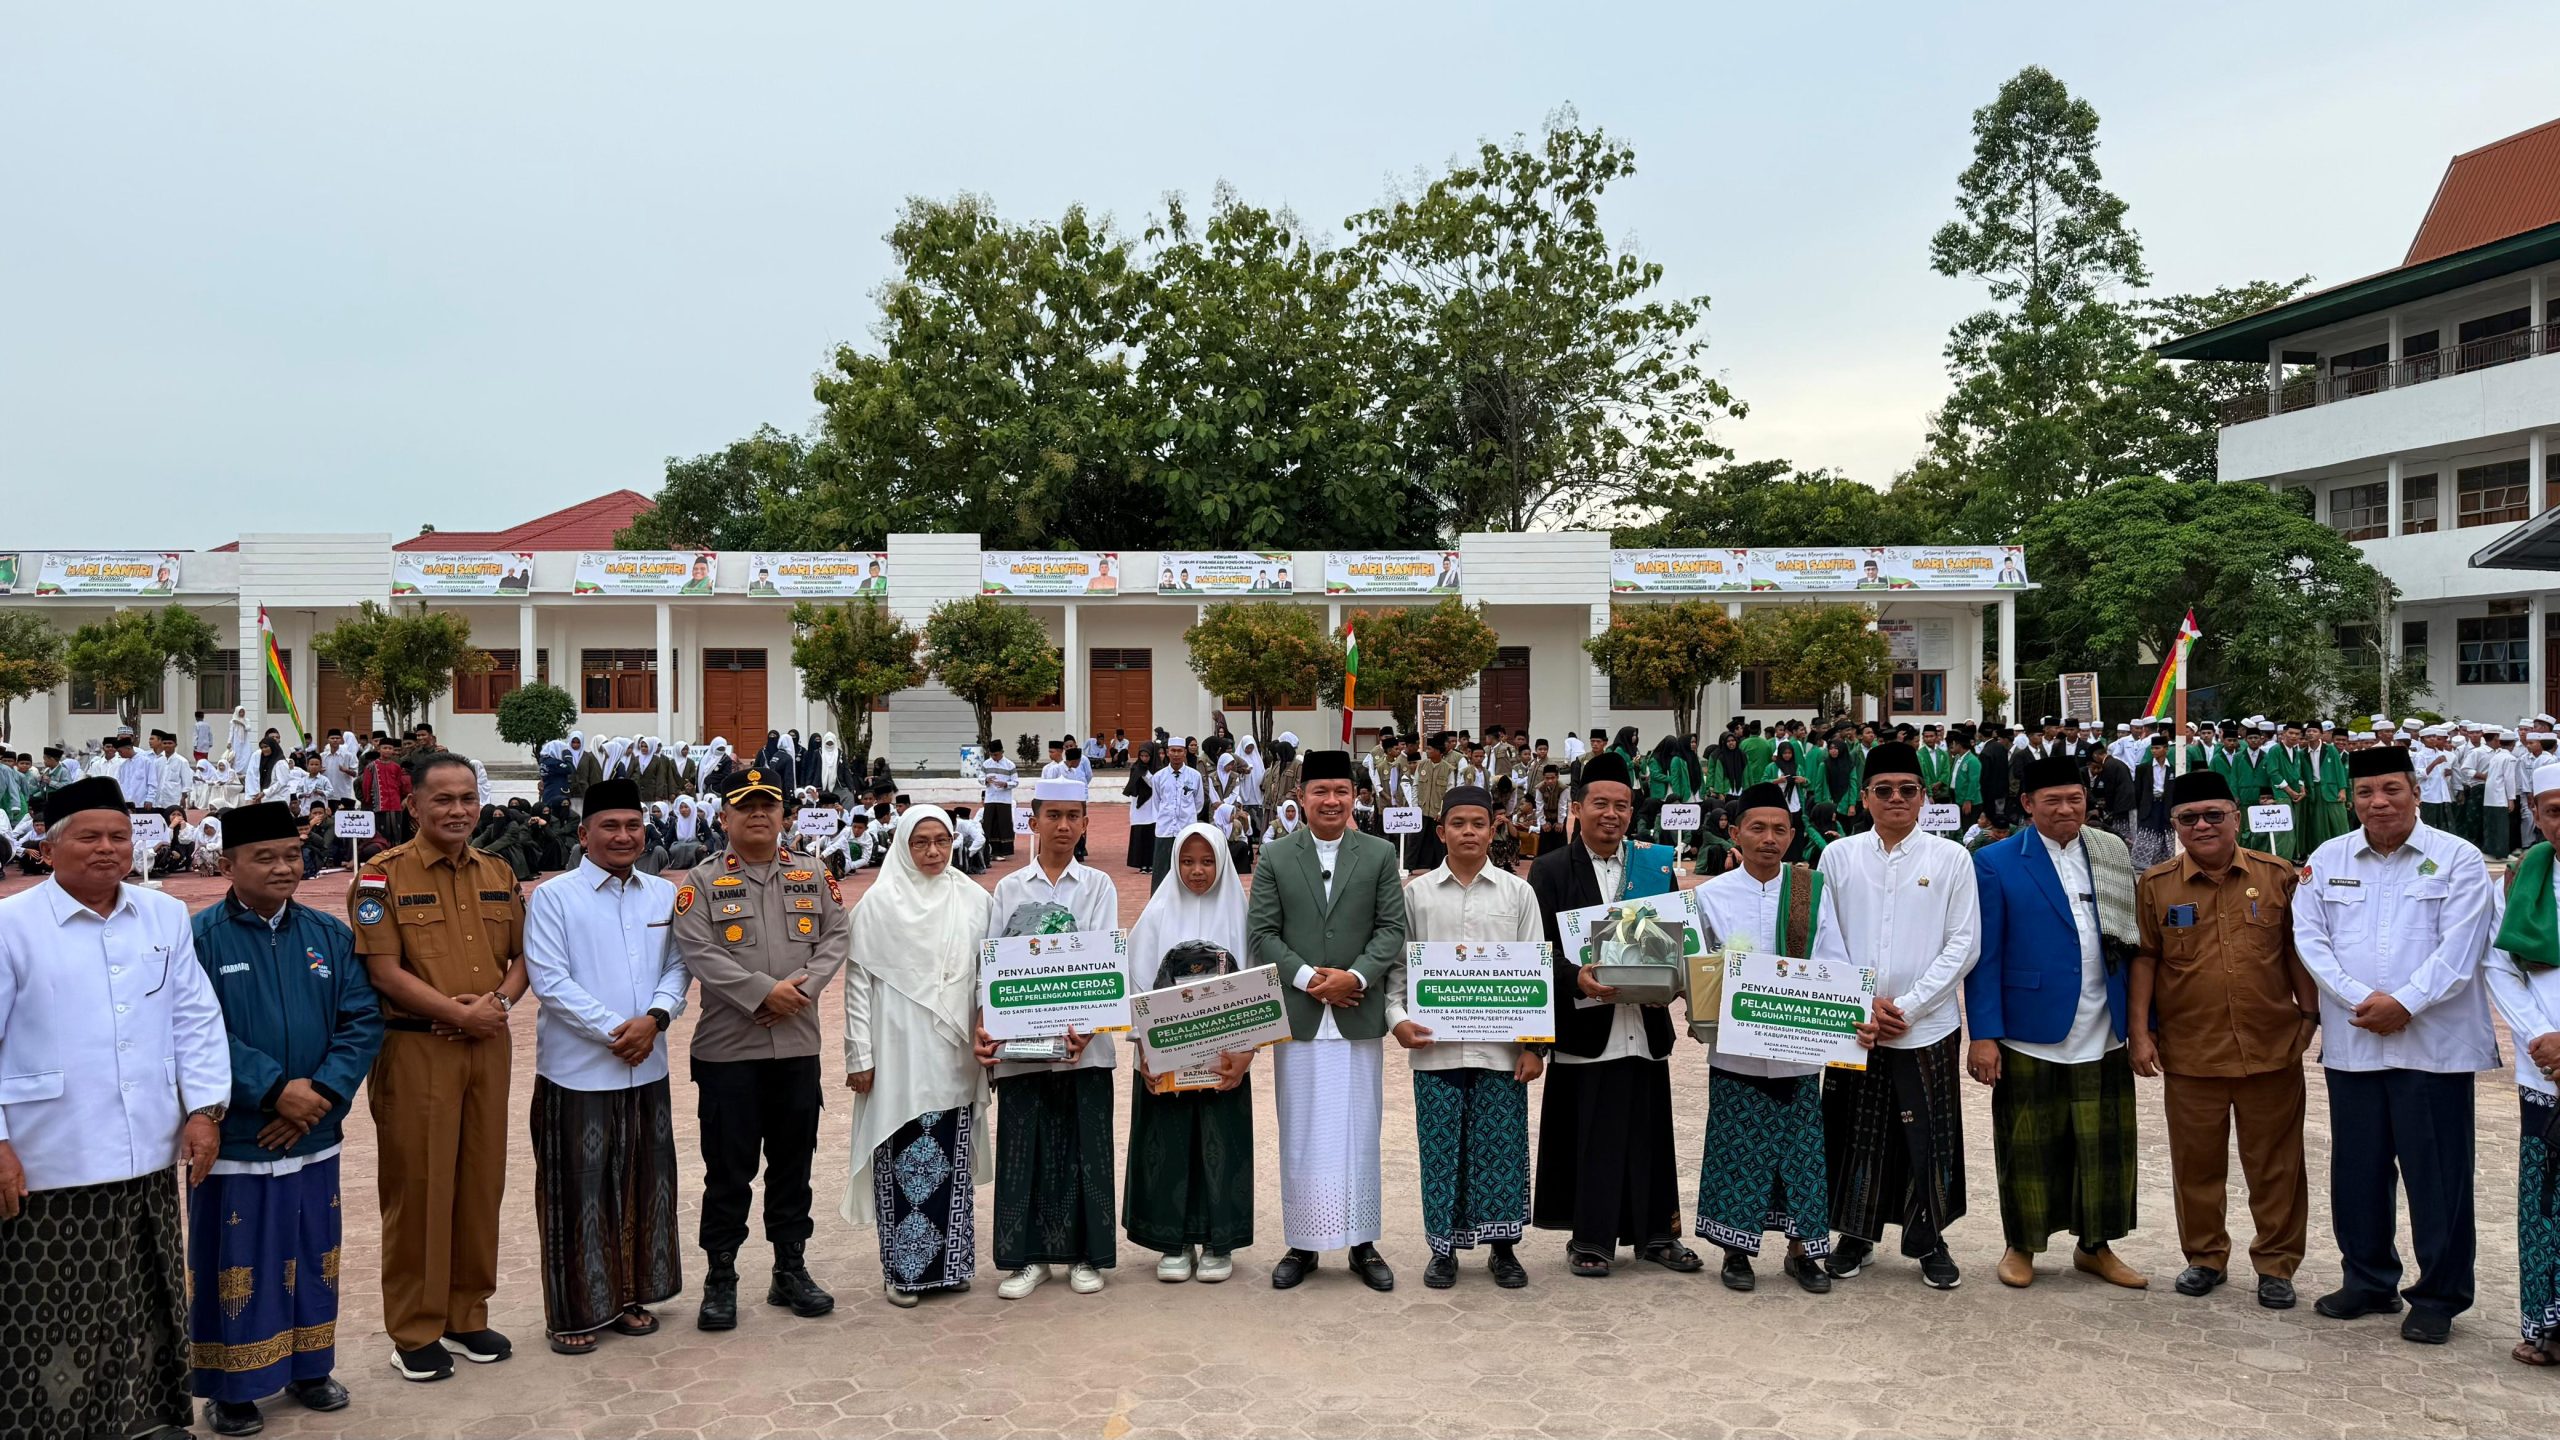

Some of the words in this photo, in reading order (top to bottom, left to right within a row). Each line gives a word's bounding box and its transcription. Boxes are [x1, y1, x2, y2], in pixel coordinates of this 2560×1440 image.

[423, 564, 455, 575] HARI
[457, 564, 503, 576] SANTRI
[605, 564, 638, 575] HARI
[640, 563, 686, 575] SANTRI
[778, 564, 810, 575] HARI
[812, 564, 858, 576] SANTRI
[1010, 564, 1042, 575] HARI
[1044, 564, 1088, 575] SANTRI
[1348, 563, 1382, 575] HARI
[1385, 563, 1435, 576] SANTRI
[1635, 561, 1669, 573] HARI
[1672, 561, 1723, 574] SANTRI
[1776, 560, 1807, 571] HARI
[1809, 560, 1855, 571] SANTRI
[1913, 558, 1945, 570] HARI
[1947, 558, 1993, 570] SANTRI
[65, 564, 99, 577] HARI
[102, 564, 153, 578] SANTRI
[1195, 576, 1218, 584] HARI
[1219, 576, 1251, 584] SANTRI
[345, 812, 364, 820] معهد
[712, 889, 746, 901] A.RAHMAT
[784, 884, 818, 894] POLRI
[998, 965, 1064, 978] PENYALURAN
[1068, 962, 1116, 972] BANTUAN
[999, 982, 1068, 994] PELALAWAN
[1071, 978, 1115, 989] CERDAS
[1424, 985, 1493, 993] PELALAWAN
[1497, 985, 1539, 994] TAQWA
[1025, 991, 1081, 1000] PERLENGKAPAN
[1741, 983, 1808, 998] PENYALURAN
[1812, 992, 1861, 1004] BANTUAN
[1154, 1005, 1220, 1025] PENYALURAN
[1223, 993, 1271, 1011] BANTUAN
[1740, 999, 1810, 1015] PELALAWAN
[1814, 1007, 1856, 1021] TAQWA
[1157, 1016, 1226, 1038] PELALAWAN
[1228, 1005, 1272, 1022] CERDAS
[1751, 1010, 1792, 1021] SAGUHATI
[1794, 1016, 1846, 1028] FISABILILLAH
[1160, 1035, 1182, 1044] PAKET
[1184, 1022, 1241, 1039] PERLENGKAPAN
[1242, 1013, 1275, 1025] SEKOLAH
[1174, 1043, 1195, 1052] SANTRI
[1240, 1022, 1277, 1035] PELALAWAN
[1754, 1031, 1799, 1041] SE-KABUPATEN
[1800, 1036, 1838, 1045] PELALAWAN
[1821, 1031, 1856, 1040] PESANTREN
